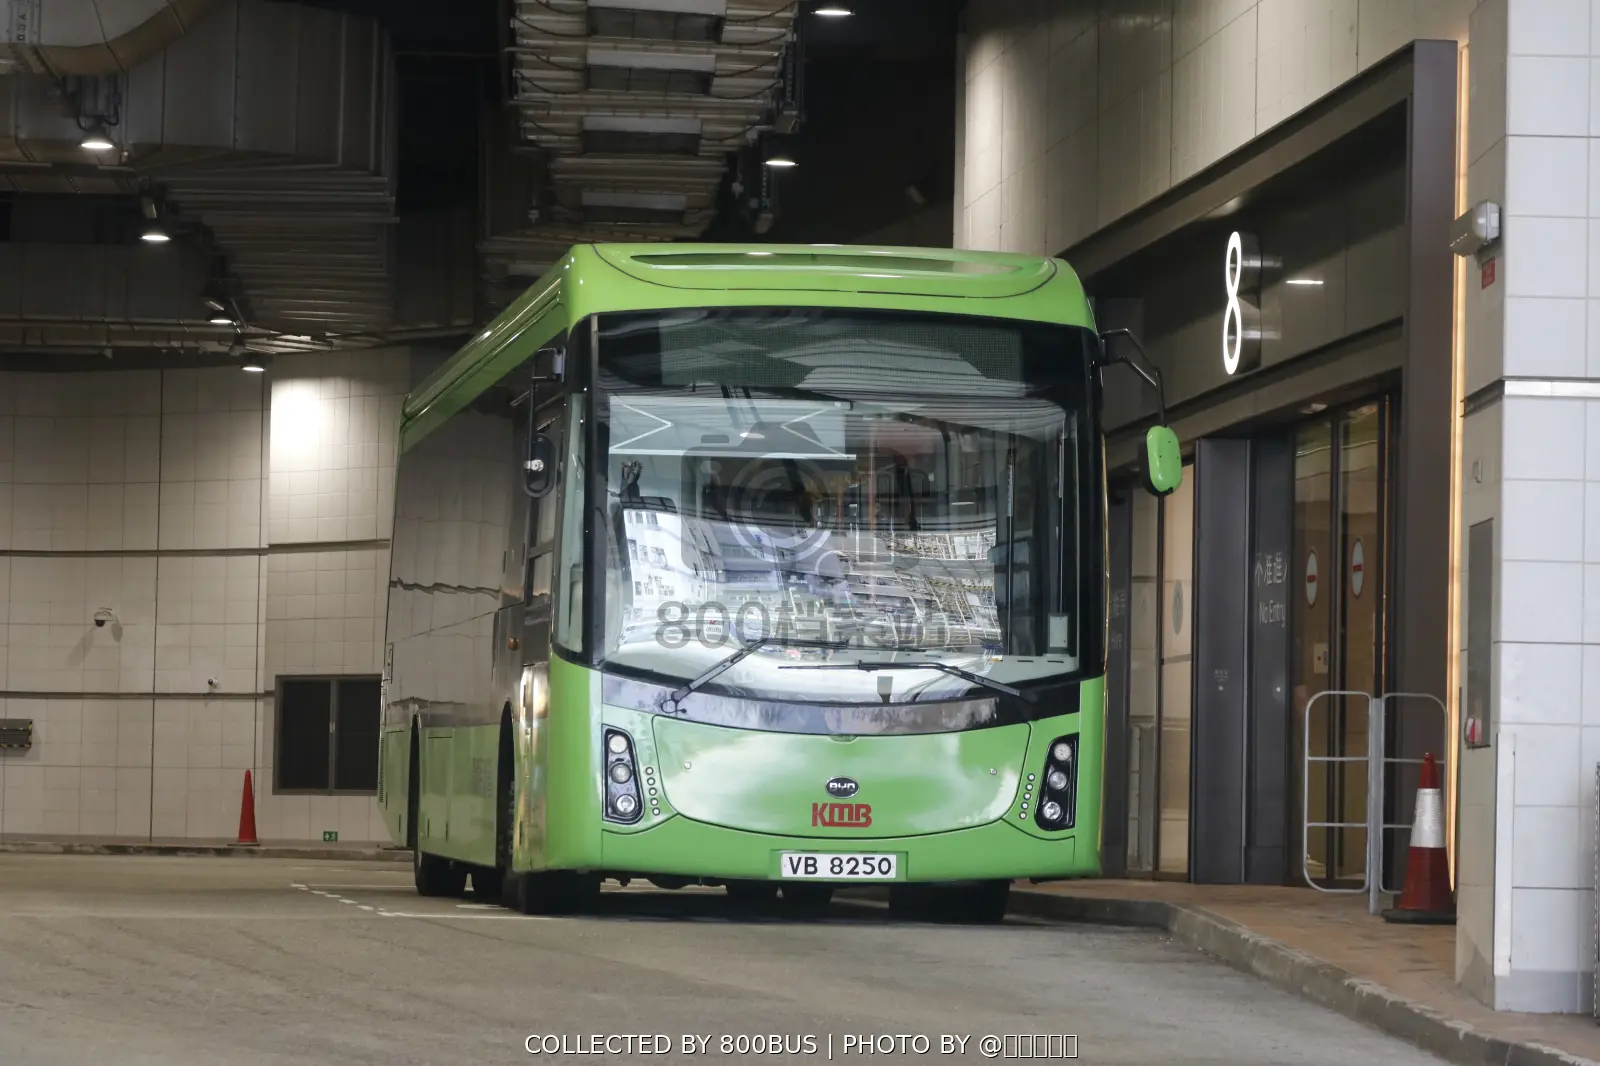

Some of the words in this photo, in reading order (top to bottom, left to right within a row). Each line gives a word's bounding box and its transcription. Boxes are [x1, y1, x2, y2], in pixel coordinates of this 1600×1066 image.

[1223, 231, 1242, 375] 8
[1259, 601, 1268, 624] No
[1269, 599, 1286, 628] Entry
[829, 782, 856, 792] BYD
[812, 802, 872, 828] KMB
[789, 856, 818, 875] VB
[829, 856, 892, 876] 8250
